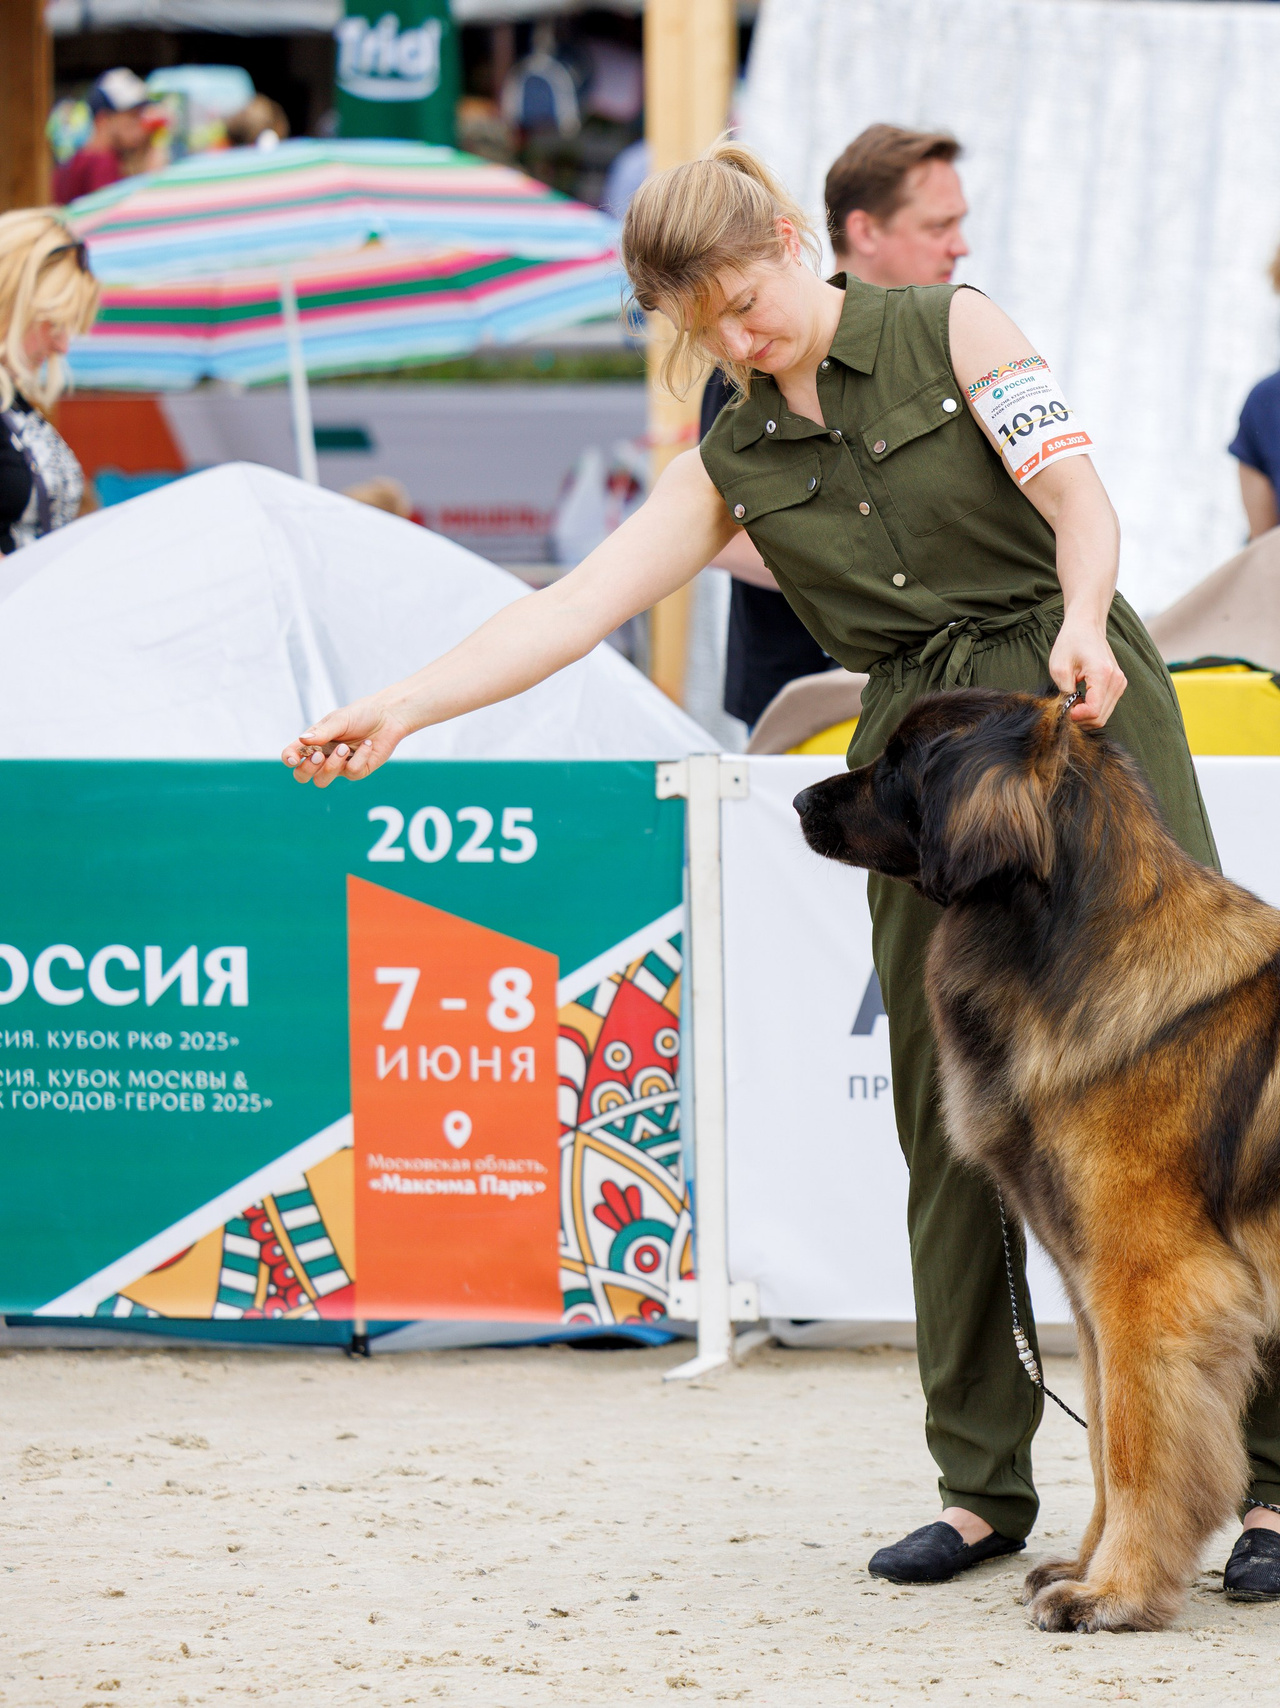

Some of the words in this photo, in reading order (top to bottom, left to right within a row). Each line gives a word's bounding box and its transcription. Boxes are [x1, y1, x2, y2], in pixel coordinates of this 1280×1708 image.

[1004, 375, 1036, 392] РОССИЯ
[998, 401, 1069, 447] 1020
[1047, 436, 1086, 451] 8.06.2025
[368, 806, 538, 864] 2025
[375, 967, 421, 1031] 7
[487, 967, 536, 1033] 8
[48, 1030, 120, 1049] КУБОК
[128, 1031, 173, 1050] РКФ
[180, 1031, 240, 1051] 2025»
[377, 1045, 536, 1083] ИЮНЯ
[48, 1068, 120, 1088] КУБОК
[129, 1069, 227, 1090] МОСКВЫ
[233, 1071, 249, 1090] &
[12, 1090, 206, 1113] ГОРОДОВ-ГЕРОЕВ
[211, 1093, 273, 1113] 2025»
[366, 1154, 471, 1172] Московская
[473, 1153, 549, 1175] область,
[368, 1173, 477, 1194] «Максима
[478, 1173, 547, 1200] Парк»
